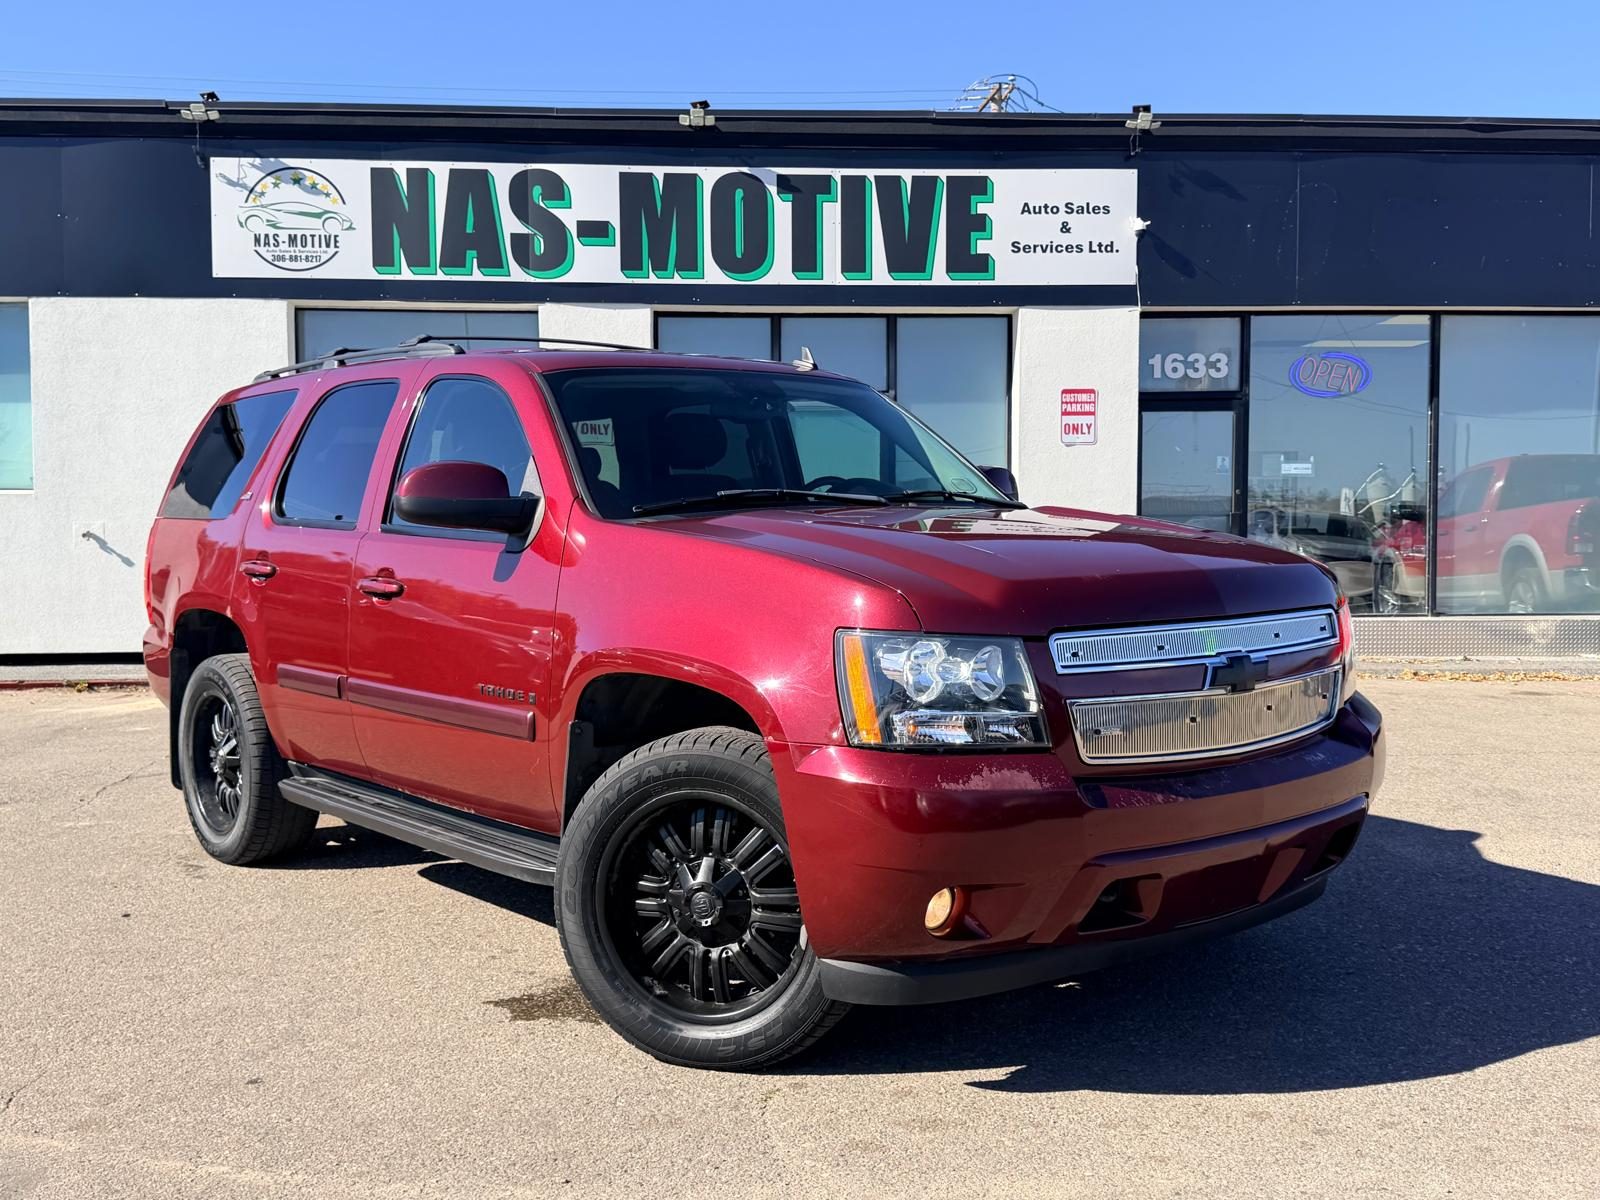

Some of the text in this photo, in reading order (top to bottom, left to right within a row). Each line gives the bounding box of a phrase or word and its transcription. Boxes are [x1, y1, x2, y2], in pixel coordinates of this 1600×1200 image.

[1020, 201, 1111, 215] Auto Sales
[370, 166, 995, 282] NAS-MOTIVE
[1059, 220, 1072, 234] &
[253, 233, 340, 249] NAS-MOTIVE
[1010, 240, 1120, 254] Services Ltd.
[1148, 353, 1229, 379] 1633
[1300, 356, 1361, 393] OPEN
[1062, 393, 1095, 402] CUSTOMER
[1062, 403, 1095, 412] PARKING
[580, 422, 610, 436] ONLY
[1064, 423, 1092, 435] ONLY
[477, 683, 525, 702] TAHOE
